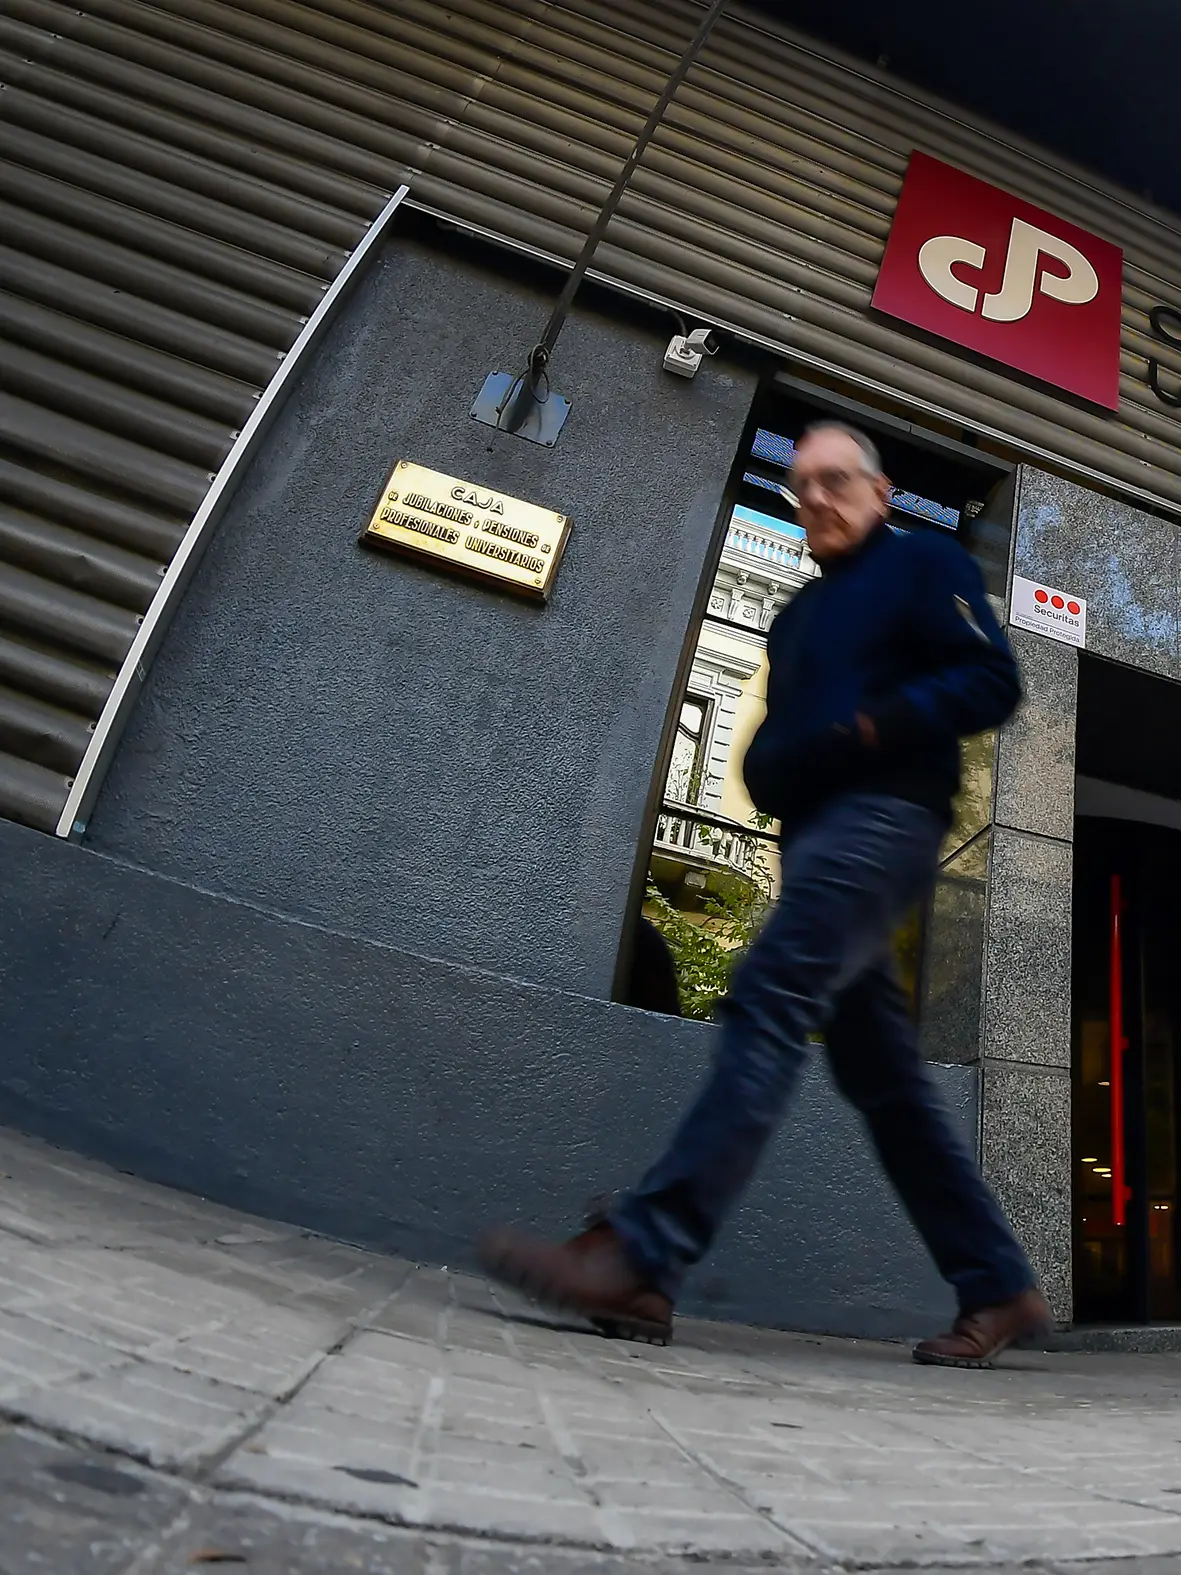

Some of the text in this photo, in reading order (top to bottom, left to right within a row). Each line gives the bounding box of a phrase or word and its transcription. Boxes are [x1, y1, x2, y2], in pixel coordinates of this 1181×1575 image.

[451, 486, 504, 515] CAJA
[402, 493, 473, 526] JUBILACIONES
[482, 518, 539, 549] PENSIONES
[541, 543, 551, 554] DE
[380, 507, 545, 574] PROFESIONALES UNIVERSITARIOS
[1015, 615, 1049, 633] Propiedad
[1049, 627, 1080, 643] Protegida
[1033, 604, 1080, 628] Securitas
